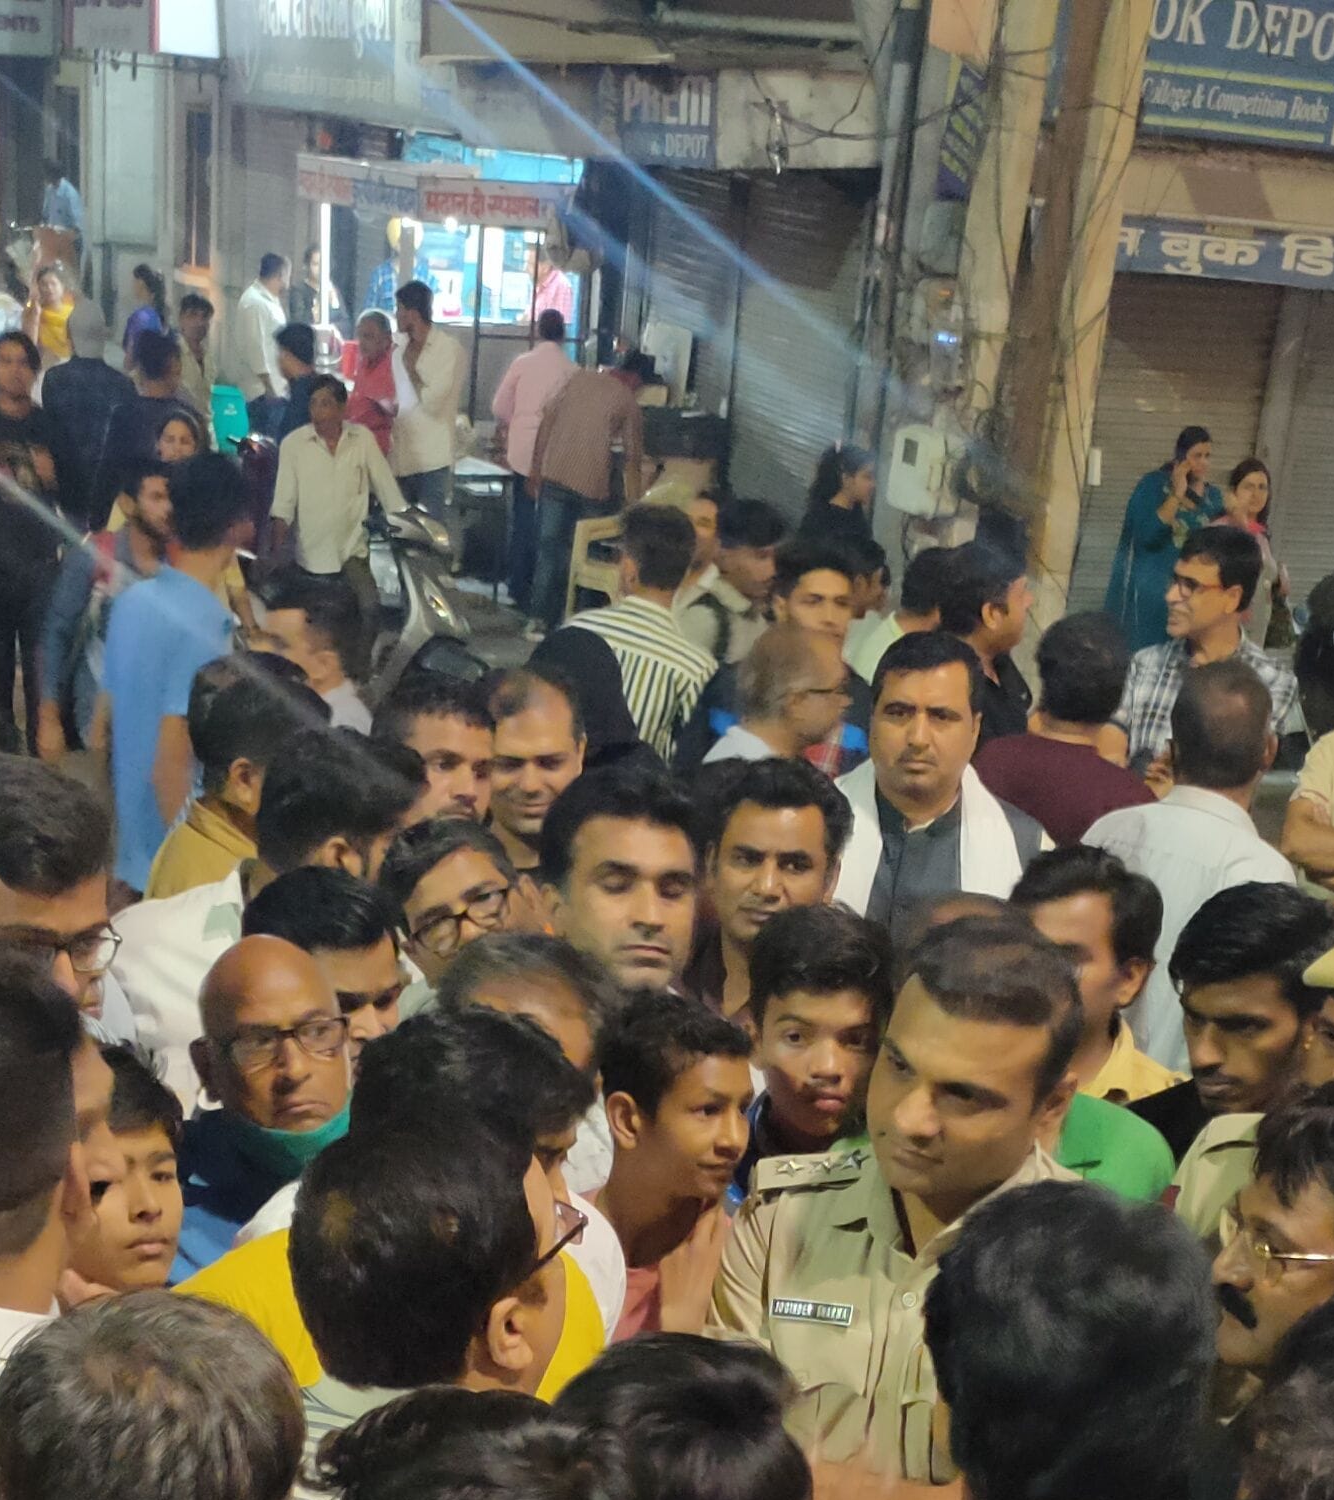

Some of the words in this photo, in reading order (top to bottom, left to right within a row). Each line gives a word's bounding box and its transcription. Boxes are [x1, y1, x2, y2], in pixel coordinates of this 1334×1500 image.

[1207, 86, 1288, 119] Competition
[1289, 96, 1330, 124] Books
[1160, 231, 1266, 276] बुक
